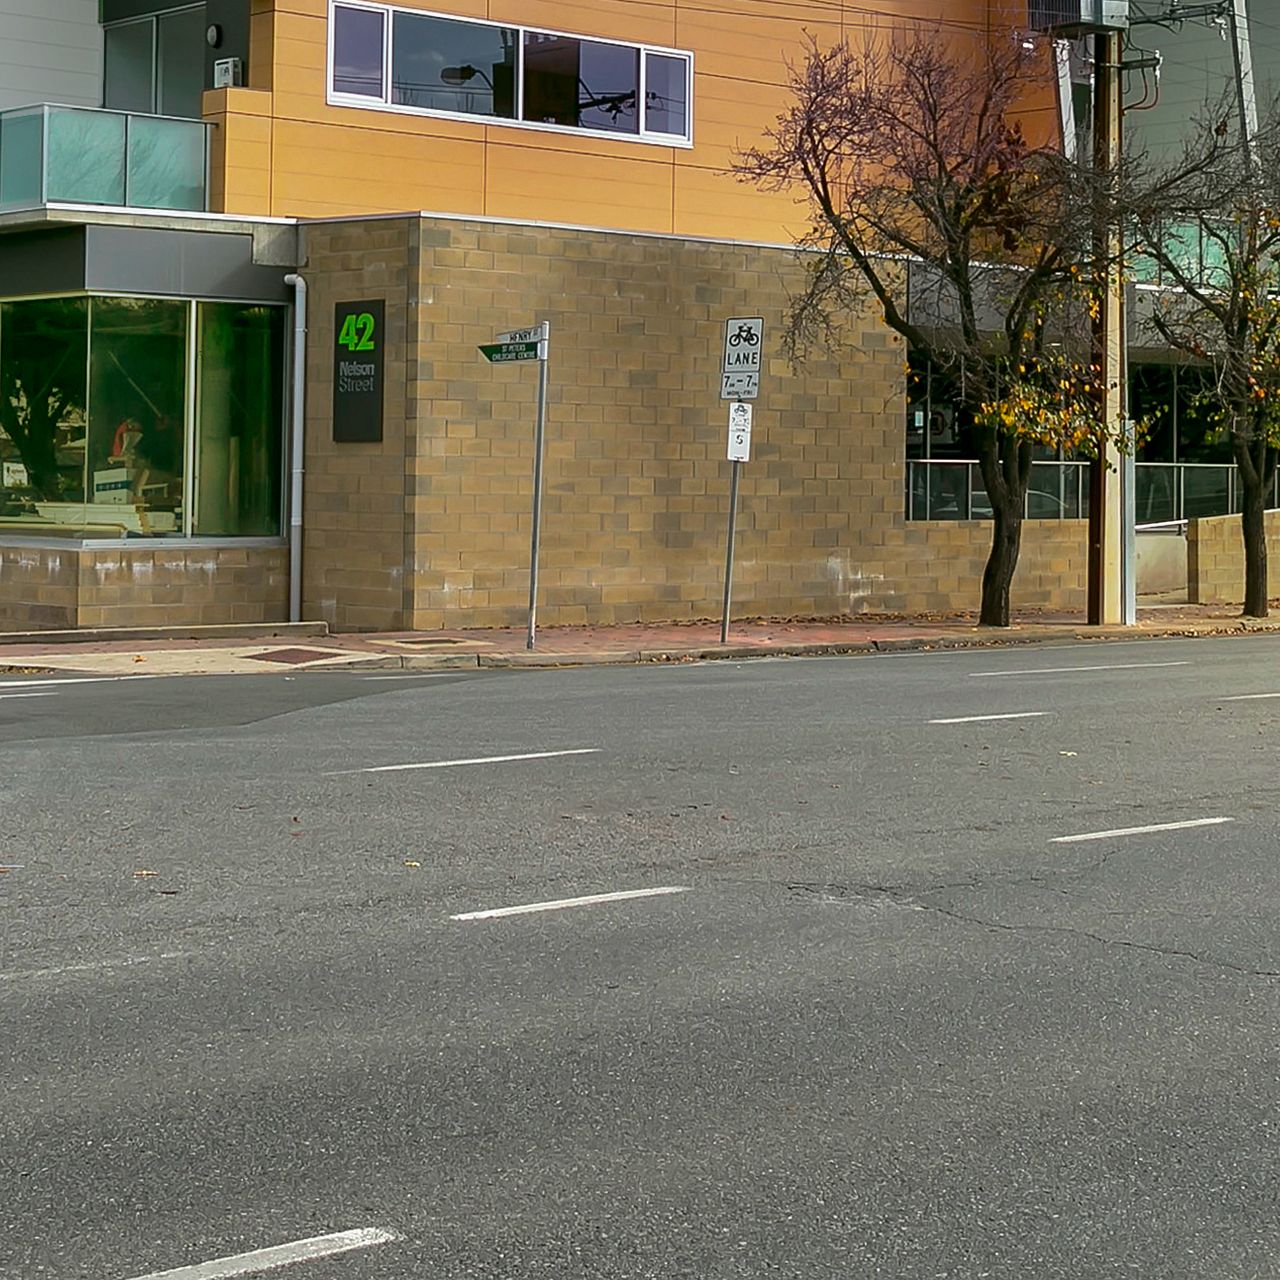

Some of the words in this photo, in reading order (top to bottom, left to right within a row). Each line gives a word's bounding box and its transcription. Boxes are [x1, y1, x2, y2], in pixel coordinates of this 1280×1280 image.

[338, 313, 375, 351] 42
[509, 330, 531, 342] HENRY
[727, 352, 758, 366] LANE
[339, 361, 375, 377] Nelson
[339, 377, 374, 392] Street
